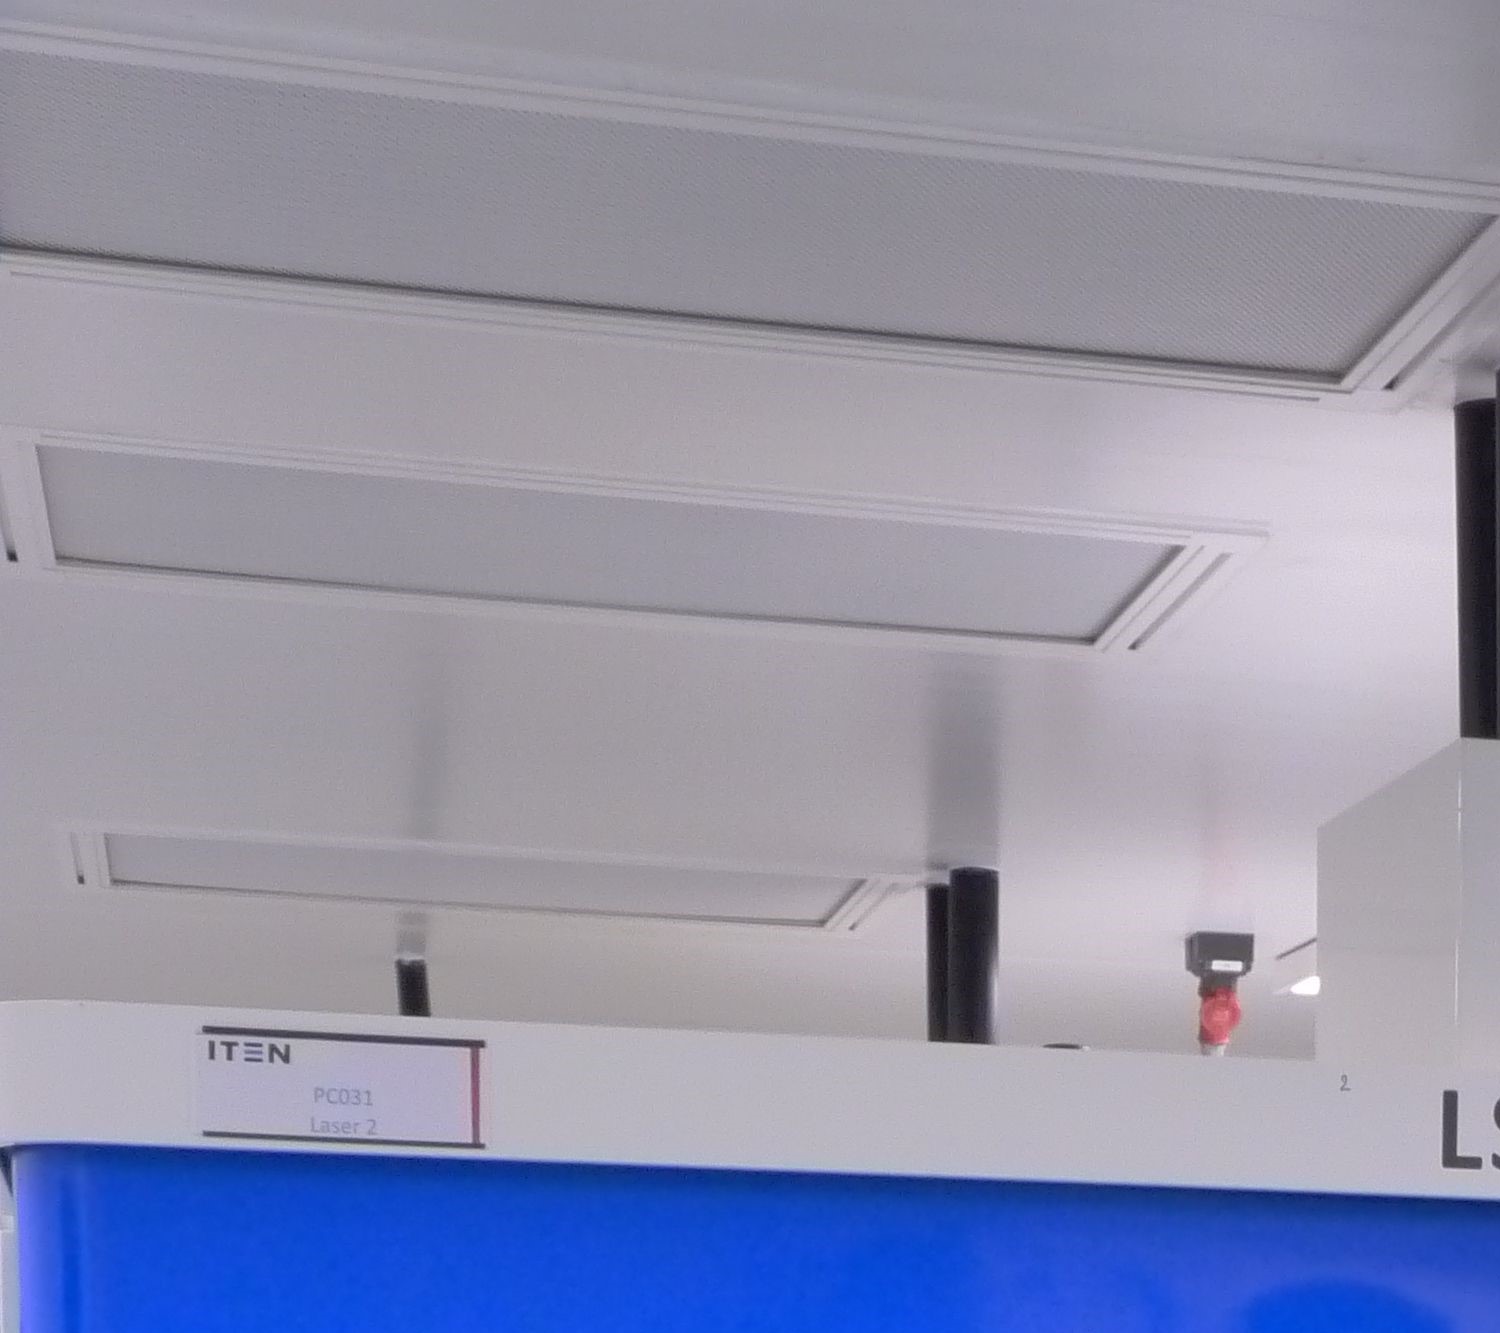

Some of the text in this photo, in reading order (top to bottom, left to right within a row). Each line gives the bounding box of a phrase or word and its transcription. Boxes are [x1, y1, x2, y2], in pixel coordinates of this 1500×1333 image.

[313, 1085, 374, 1107] PC031
[310, 1116, 378, 1136] Laser 2
